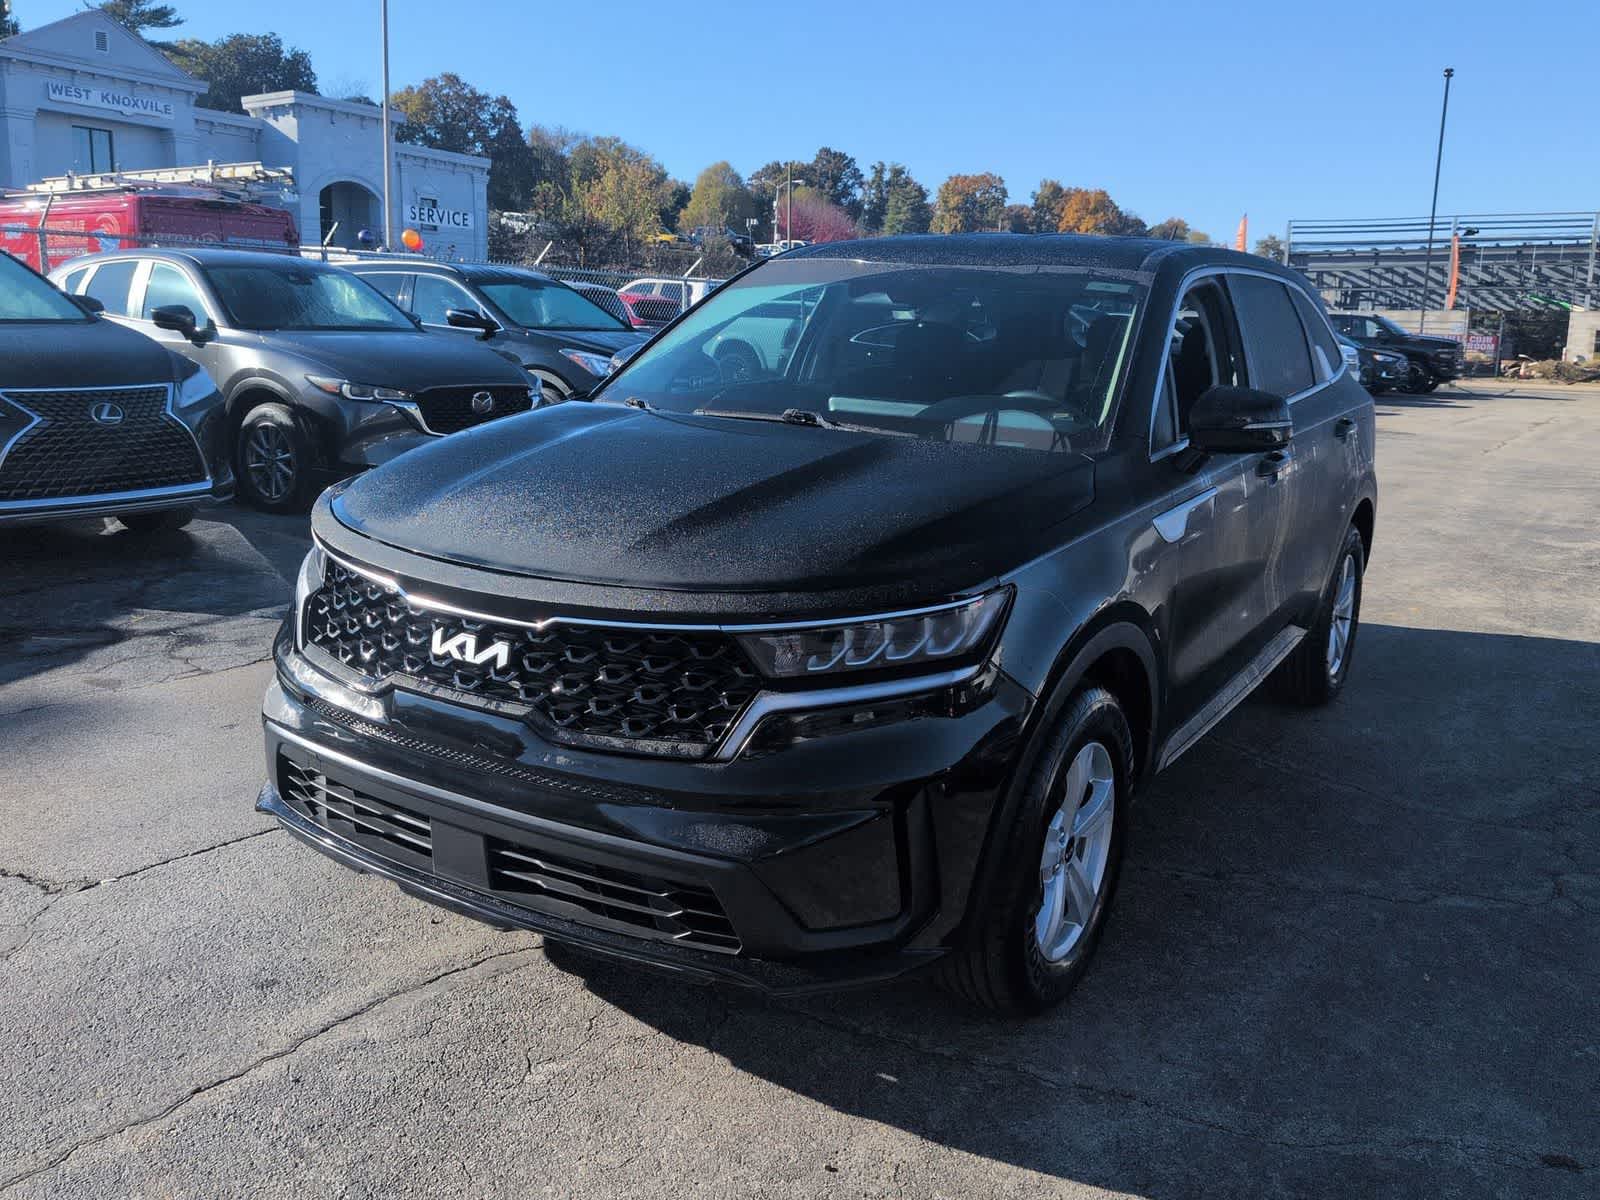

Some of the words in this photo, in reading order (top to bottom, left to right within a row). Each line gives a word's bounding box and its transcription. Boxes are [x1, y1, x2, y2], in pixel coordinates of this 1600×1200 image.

[49, 83, 92, 100] WEST
[101, 92, 173, 115] KNOXVILE
[410, 206, 469, 227] SERVICE
[431, 626, 510, 670] KIA
